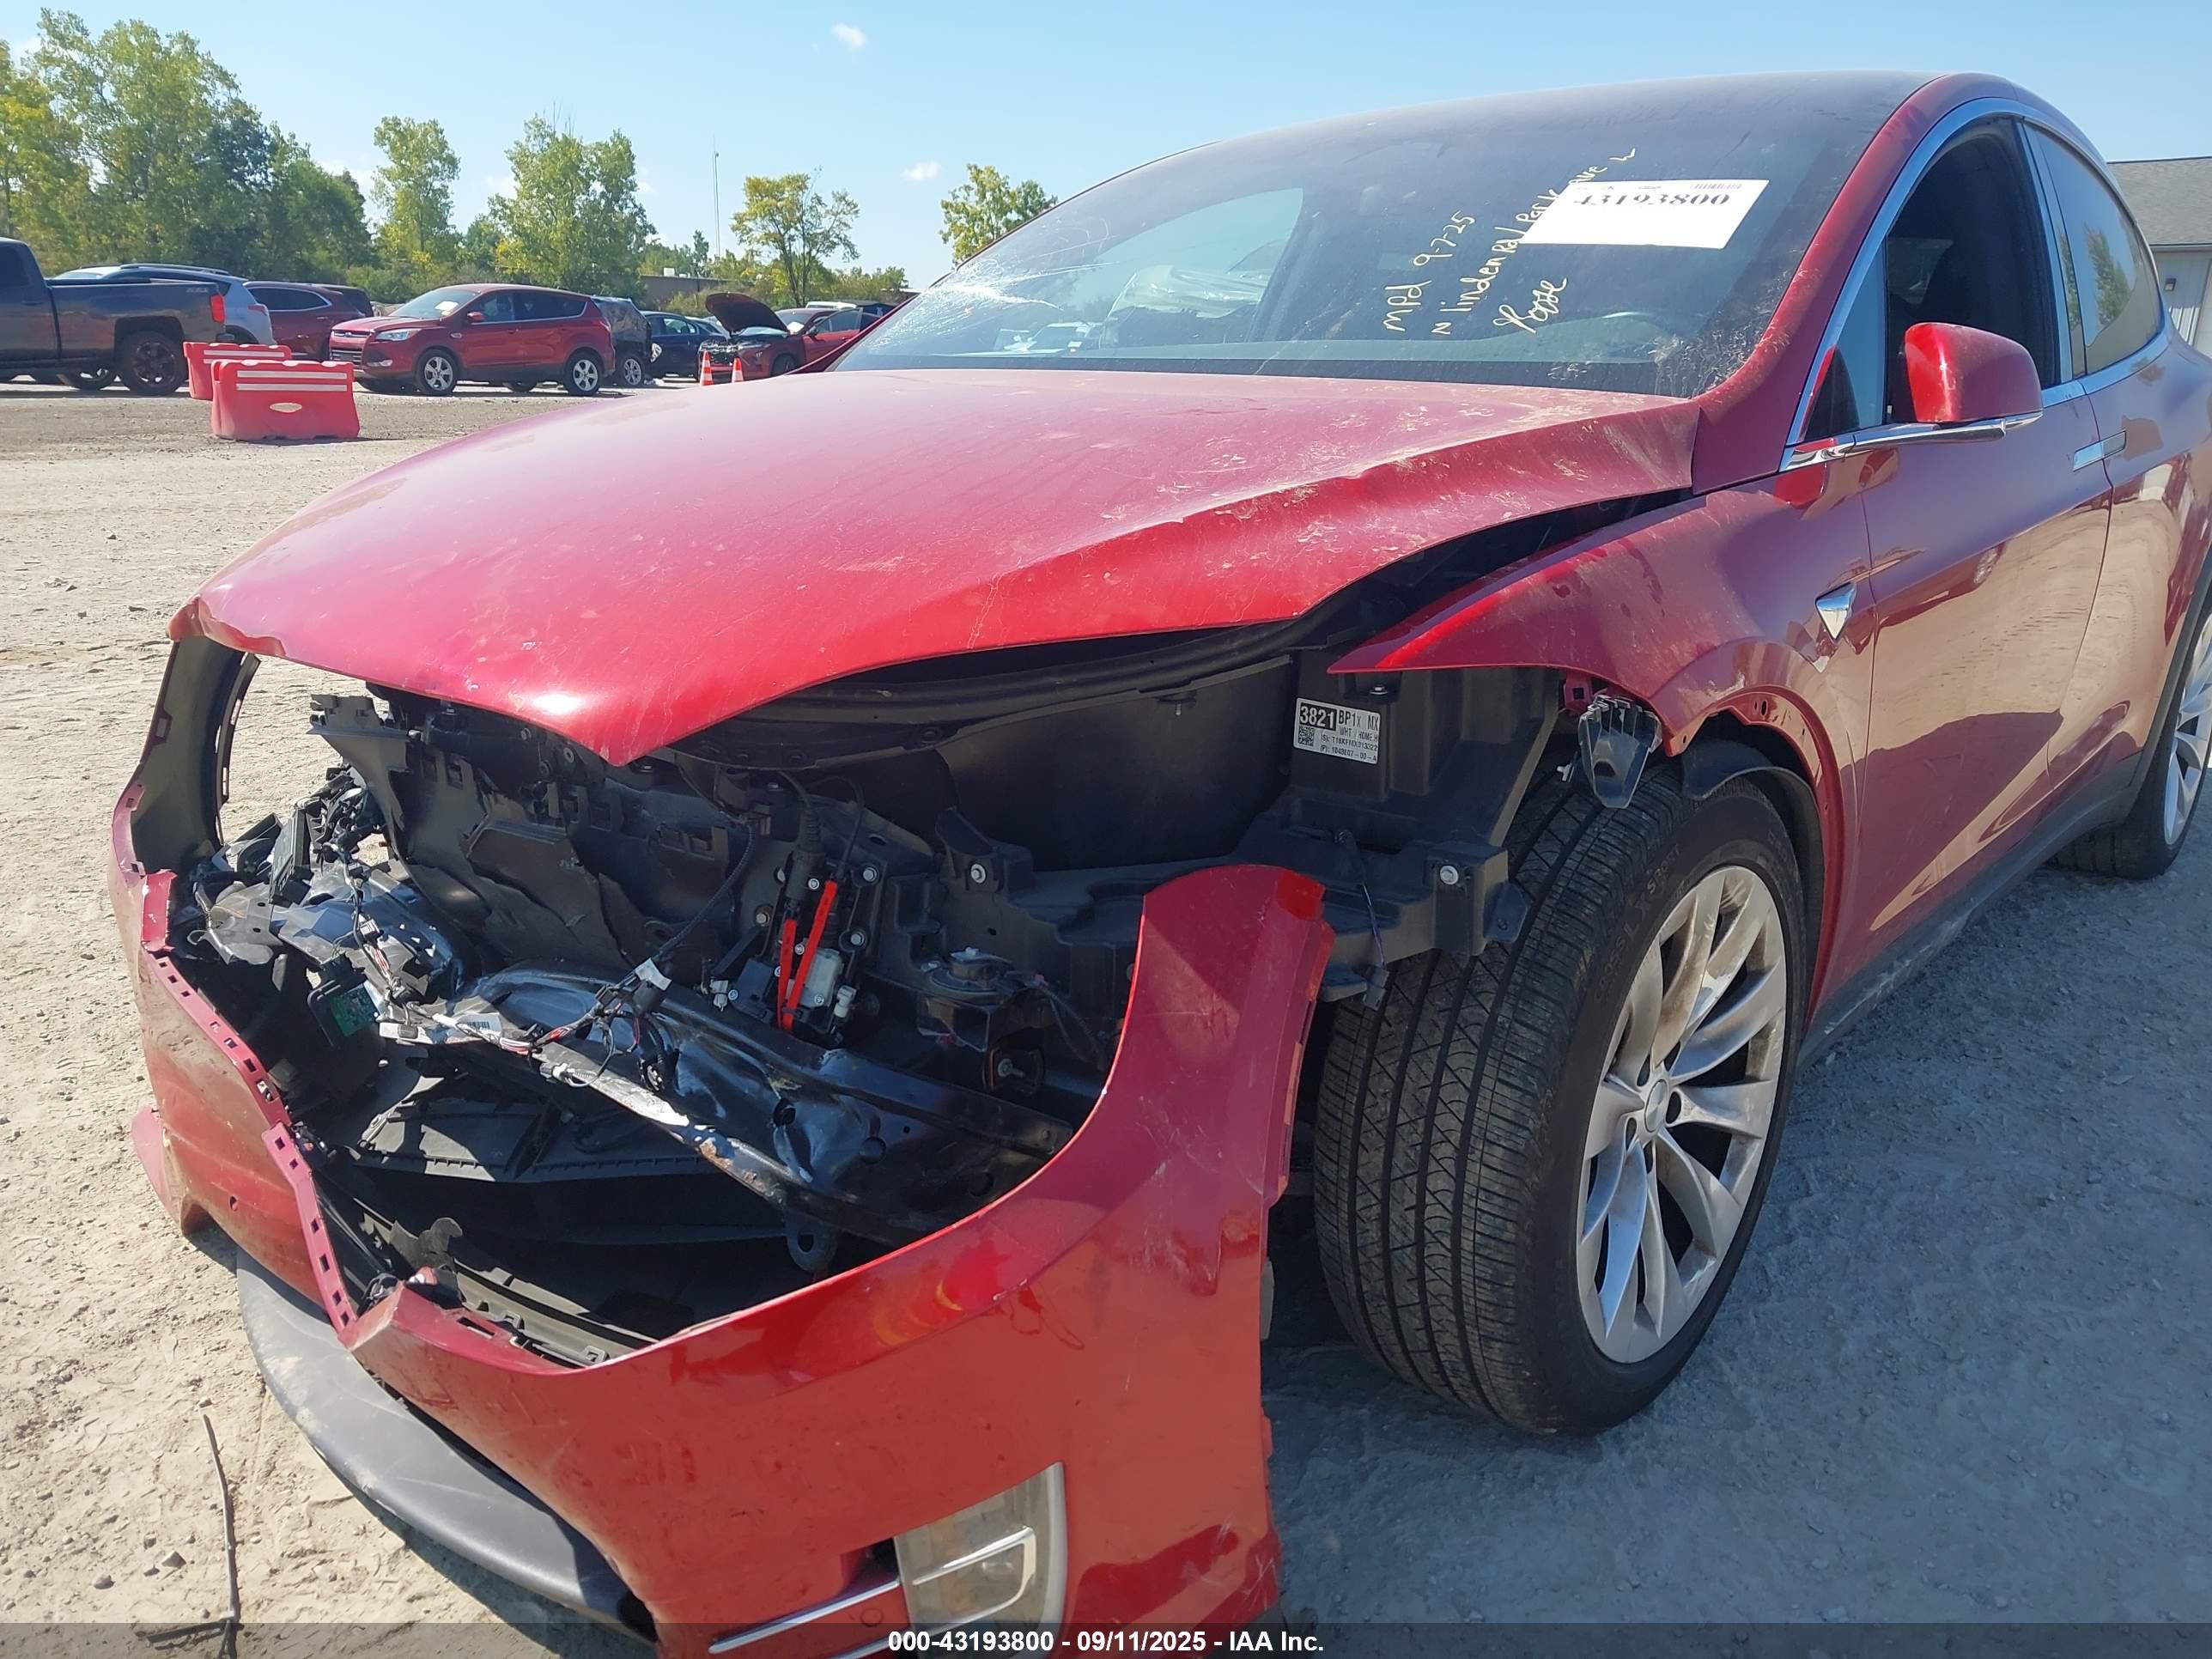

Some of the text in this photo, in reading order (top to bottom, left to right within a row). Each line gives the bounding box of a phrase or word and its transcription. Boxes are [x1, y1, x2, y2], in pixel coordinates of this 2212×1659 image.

[1574, 194, 1730, 205] 43193800
[1413, 210, 1476, 266] 9-7-25
[1299, 705, 1335, 729] 3821
